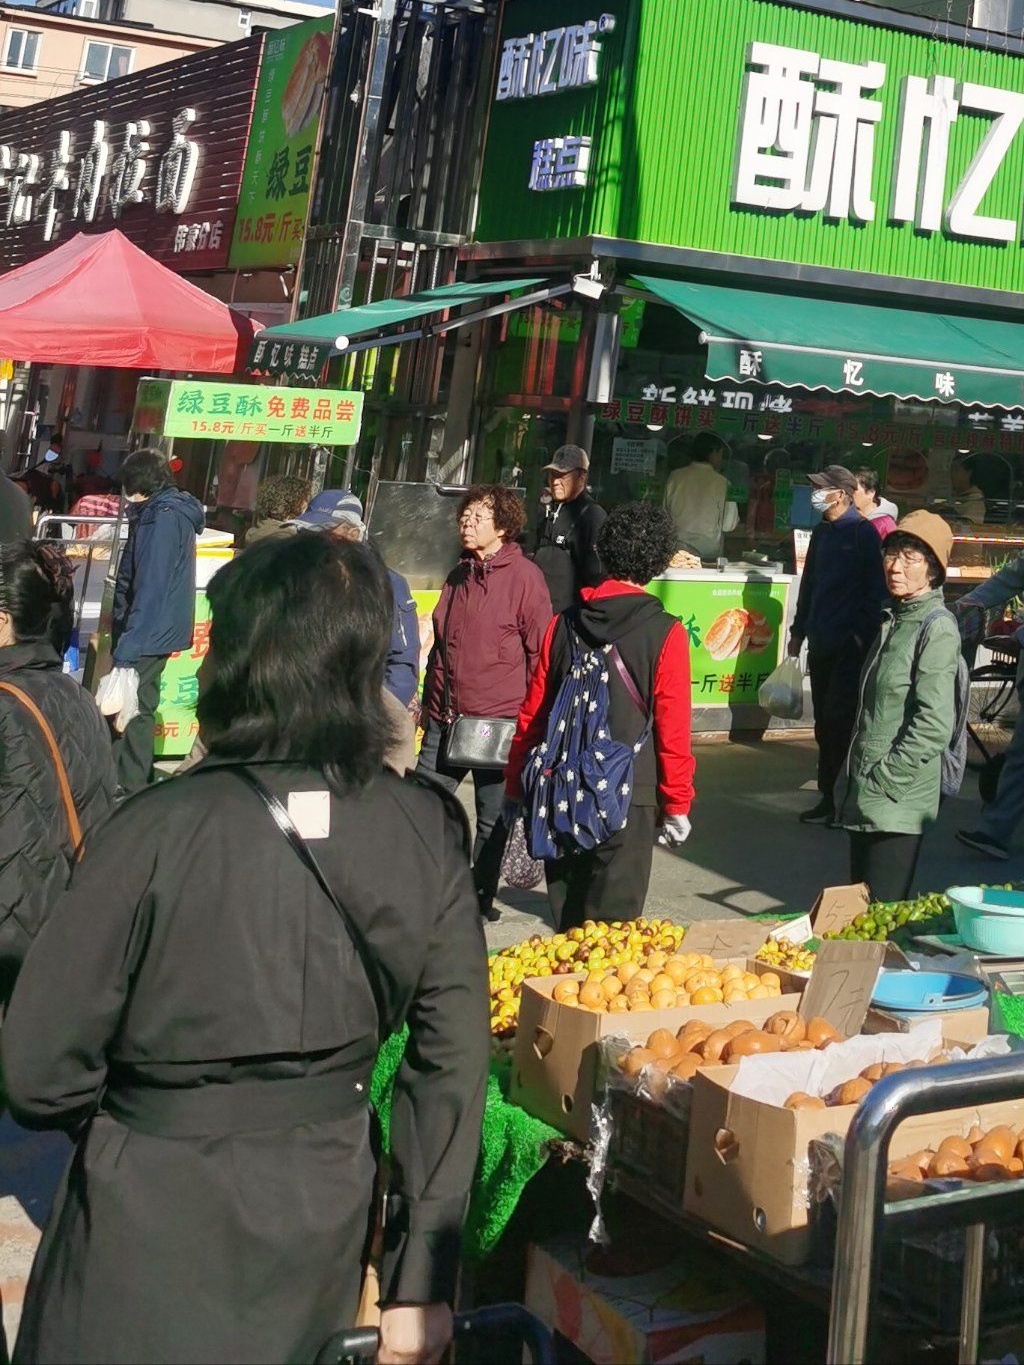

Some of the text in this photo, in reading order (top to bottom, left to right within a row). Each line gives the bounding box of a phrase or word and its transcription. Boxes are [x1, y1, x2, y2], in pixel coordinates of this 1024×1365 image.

[496, 20, 601, 101] 酥忆味
[529, 135, 591, 191] 糕点
